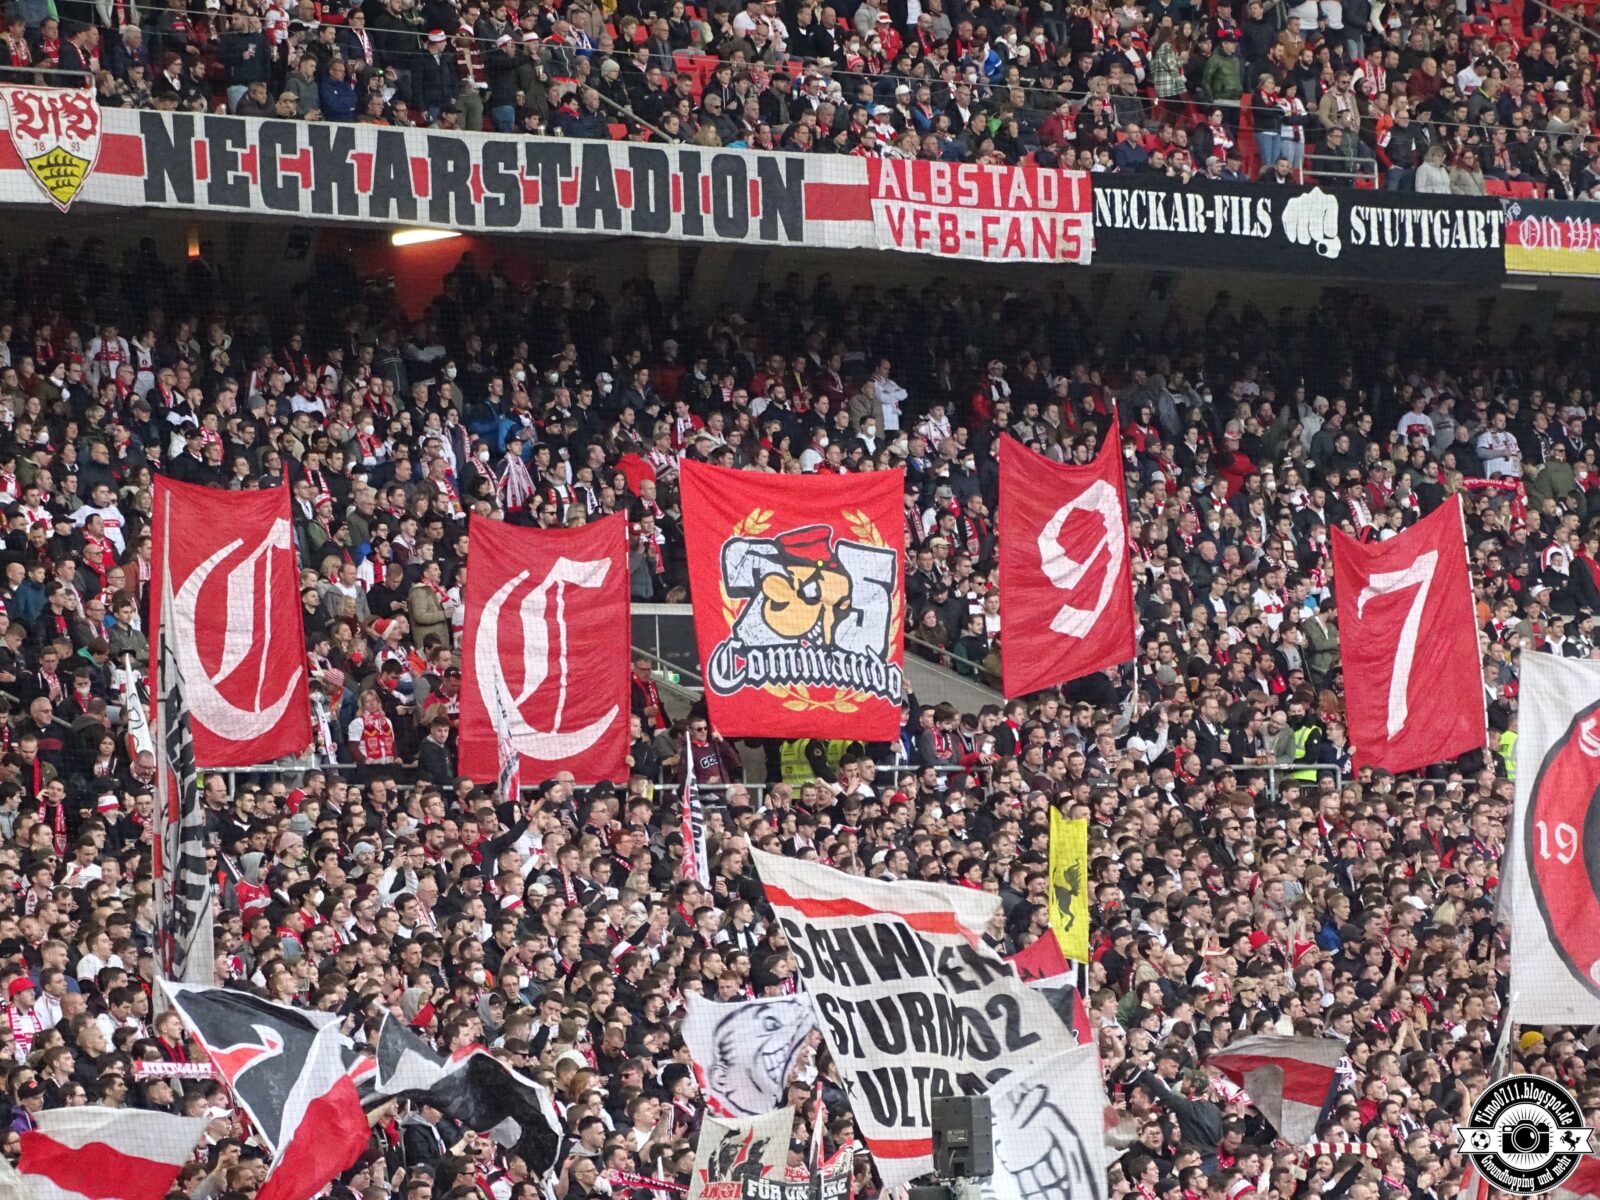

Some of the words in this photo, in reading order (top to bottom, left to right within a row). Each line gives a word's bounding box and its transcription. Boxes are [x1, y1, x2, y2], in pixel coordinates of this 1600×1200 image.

[33, 142, 46, 151] 18
[140, 111, 804, 242] NECKARSTADION
[878, 160, 1087, 211] ALBSTADT
[884, 205, 1082, 259] VFB-FANS
[1093, 187, 1272, 237] NECKAR-FILS
[1350, 205, 1504, 249] STUTTGART
[1519, 214, 1561, 251] Old
[1038, 479, 1125, 638] 9
[474, 556, 619, 761] C
[709, 640, 903, 702] Commando
[1357, 550, 1439, 741] 7
[1535, 820, 1578, 865] 19
[747, 1178, 781, 1200] FÜR
